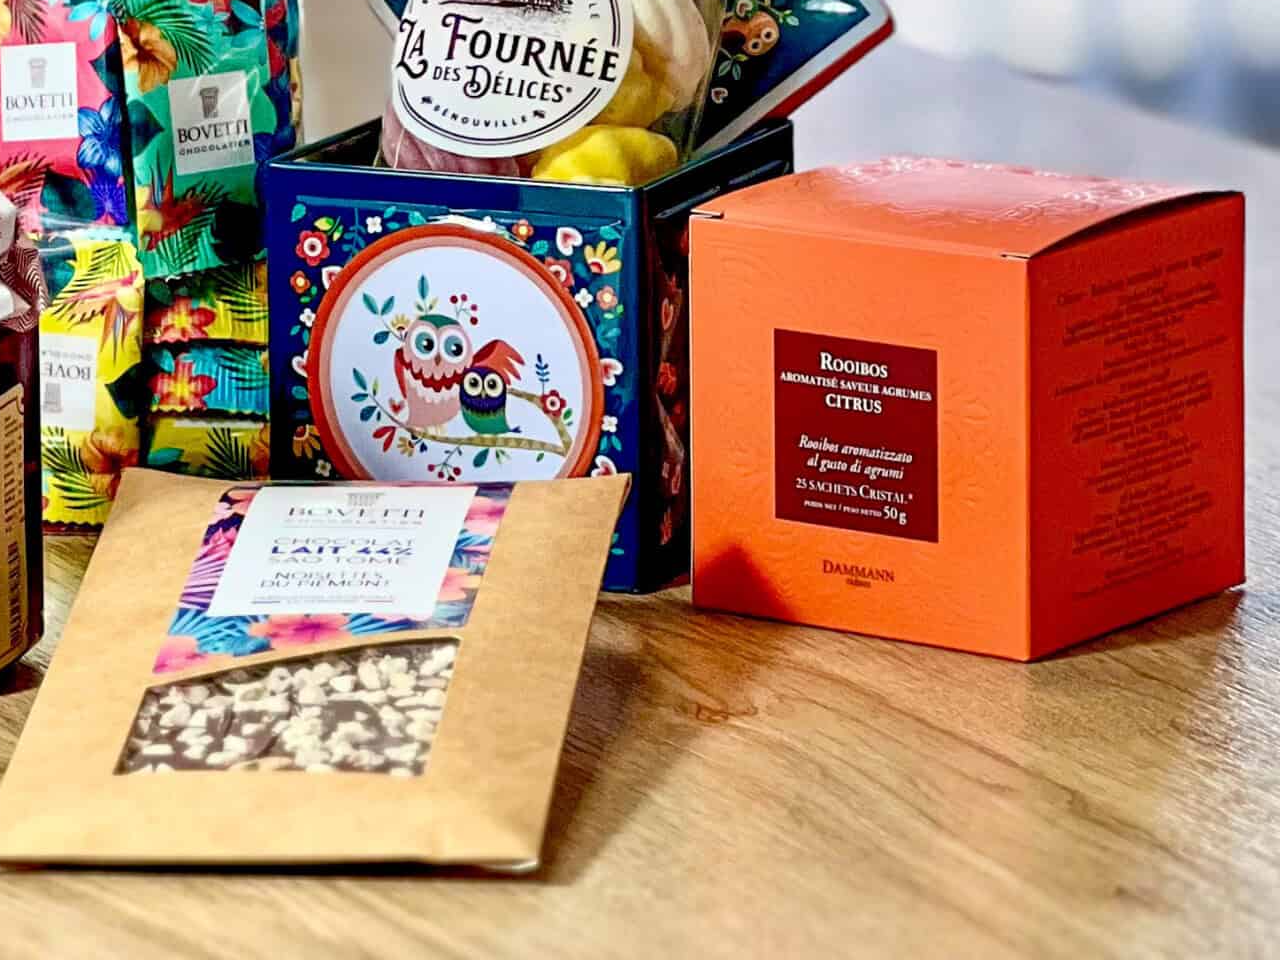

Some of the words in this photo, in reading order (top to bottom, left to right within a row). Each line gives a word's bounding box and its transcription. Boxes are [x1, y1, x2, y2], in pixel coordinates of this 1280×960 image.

[5, 93, 73, 111] BOVETTI
[177, 119, 249, 144] BOVETTI
[179, 139, 251, 156] CHOCOLATIER
[839, 379, 880, 395] SAVEUR
[825, 393, 883, 415] CITRUS
[798, 433, 840, 453] Rooibos
[840, 444, 913, 464] aromatizzato
[807, 453, 819, 467] al
[819, 458, 848, 473] gusto
[850, 458, 862, 474] di
[864, 466, 905, 481] agrumi
[796, 478, 807, 489] 25
[883, 505, 898, 519] 50
[899, 511, 907, 525] g
[271, 545, 347, 555] LAIT
[273, 537, 415, 547] CHOCOLAT
[822, 558, 895, 583] DAMMANN
